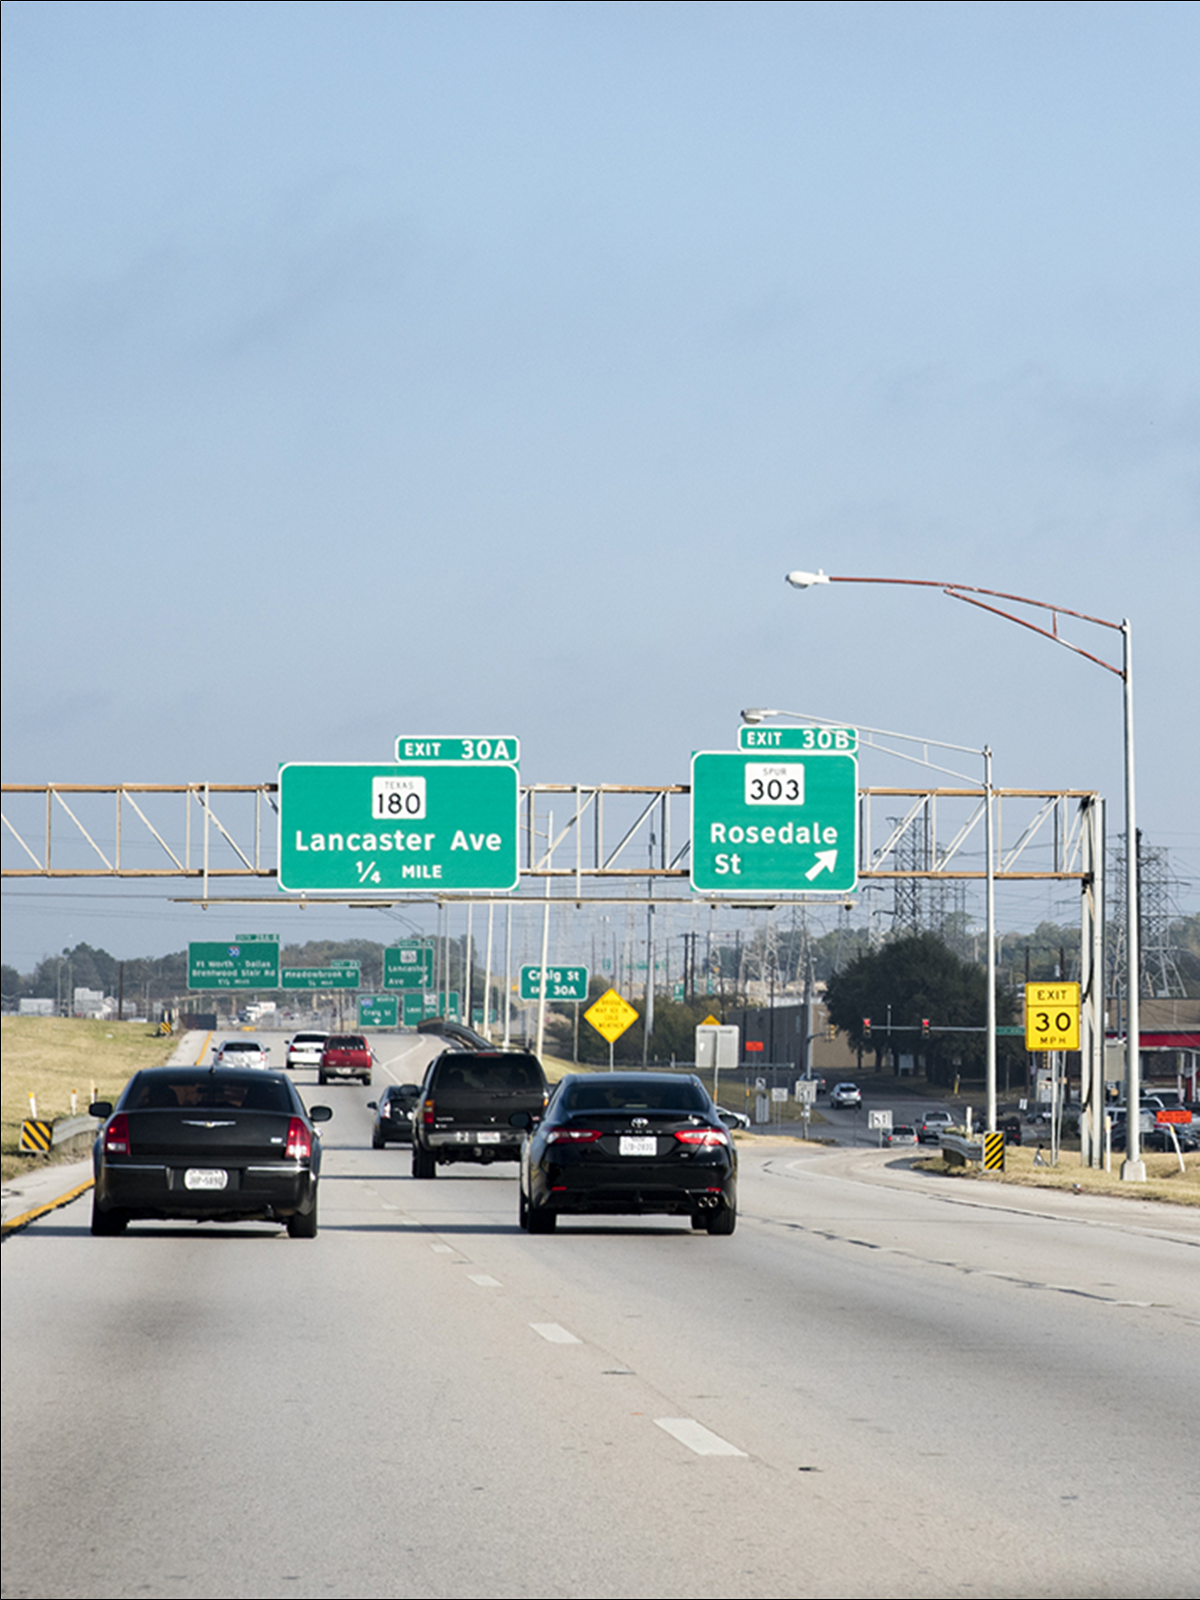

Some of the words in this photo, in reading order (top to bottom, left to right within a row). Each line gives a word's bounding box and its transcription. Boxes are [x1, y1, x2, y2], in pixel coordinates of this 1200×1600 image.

[747, 732, 782, 745] EXIT
[802, 730, 850, 749] 30B
[404, 743, 442, 757] EXIT
[461, 740, 510, 759] 30A
[762, 767, 787, 776] SPUR
[384, 781, 414, 790] TEXAS
[750, 779, 800, 800] 303
[377, 793, 421, 814] 180
[295, 830, 436, 851] Lancaster
[450, 830, 502, 851] Ave
[710, 822, 838, 844] Rosedale
[402, 865, 442, 878] MILE
[714, 853, 741, 875] St
[208, 960, 234, 968] Worth
[245, 960, 271, 968] Dallas
[192, 969, 238, 977] Brentwood
[241, 969, 260, 977] Stair
[264, 969, 276, 977] Rd
[567, 970, 580, 981] St
[553, 985, 577, 996] 30A
[1037, 990, 1067, 1000] EXIT
[1035, 1012, 1071, 1031] 30
